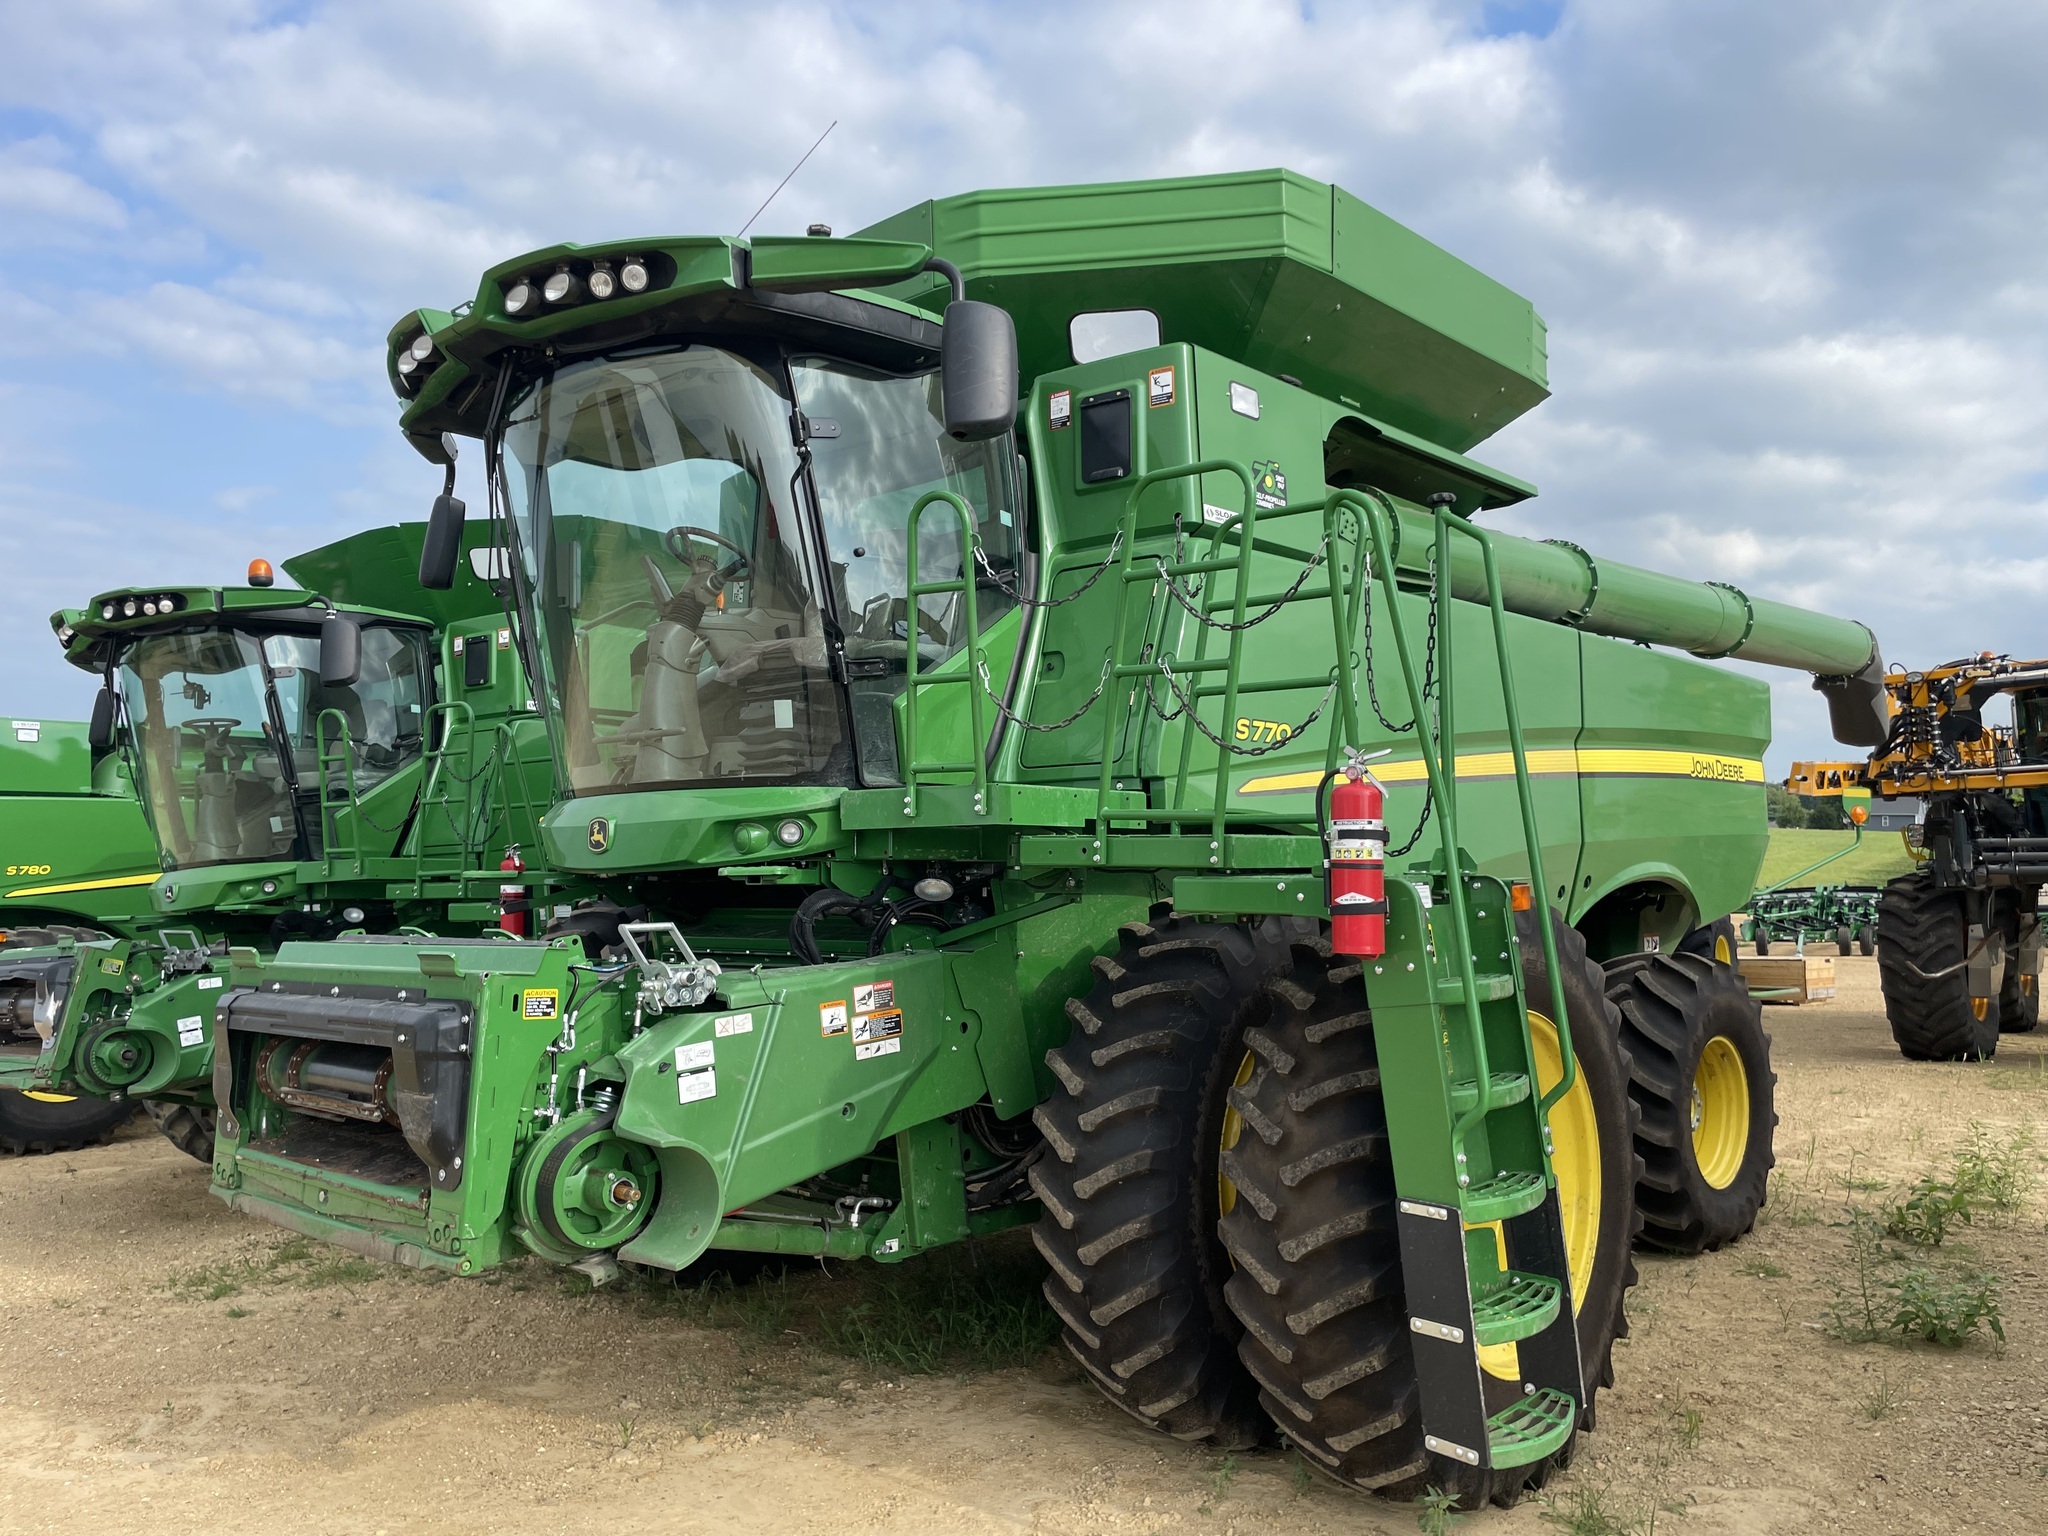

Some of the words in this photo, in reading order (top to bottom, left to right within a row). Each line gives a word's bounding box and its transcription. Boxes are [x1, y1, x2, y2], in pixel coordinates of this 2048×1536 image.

[1214, 510, 1233, 518] SLOA
[1235, 716, 1292, 743] S770
[1690, 756, 1715, 776] JOHN
[1715, 759, 1745, 779] DEERE
